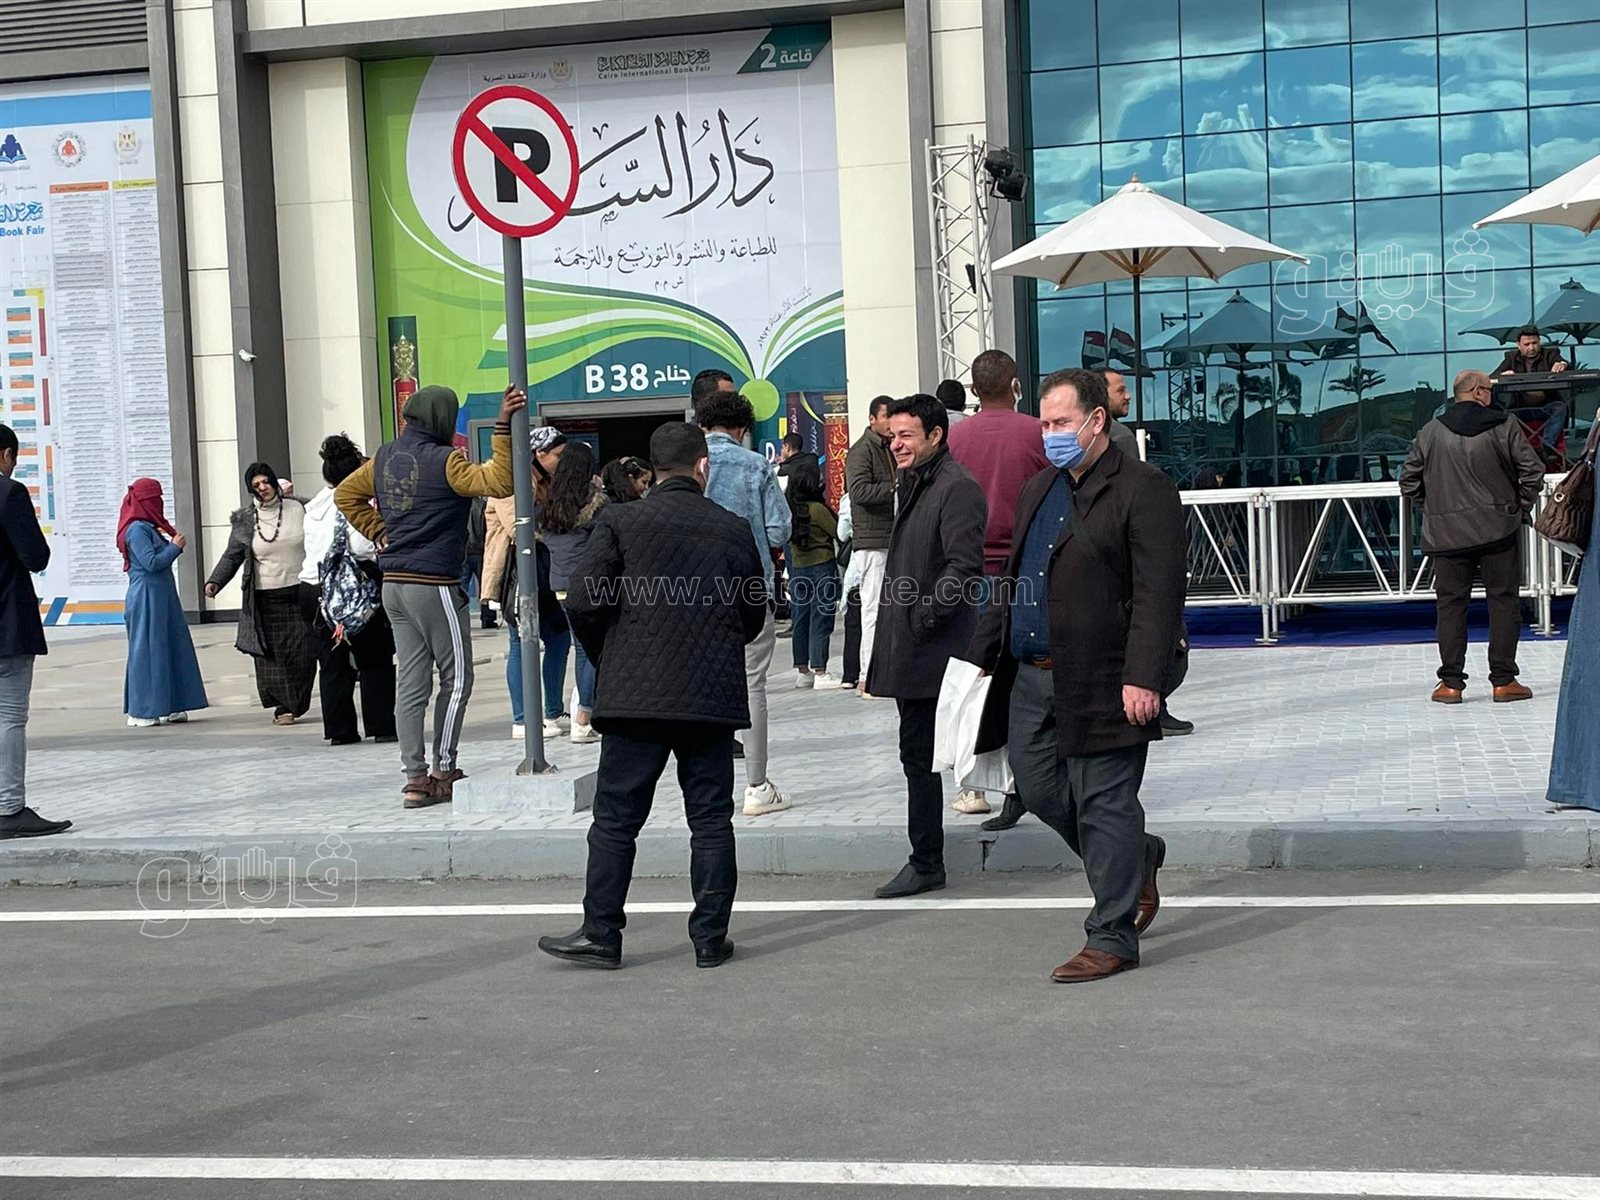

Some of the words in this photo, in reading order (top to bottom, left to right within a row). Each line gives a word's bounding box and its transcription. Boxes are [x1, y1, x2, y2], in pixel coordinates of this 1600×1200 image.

[760, 43, 777, 69] 2
[780, 48, 813, 64] قاعة
[506, 71, 530, 80] الثقافة
[530, 71, 547, 81] وزارة
[598, 72, 619, 80] Cairo
[620, 67, 672, 78] International
[673, 65, 694, 74] Book
[695, 64, 712, 73] Fair
[491, 126, 552, 204] P
[0, 226, 23, 237] Book
[26, 224, 46, 236] Fair
[729, 236, 777, 263] للطباعة
[653, 364, 692, 389] جناح
